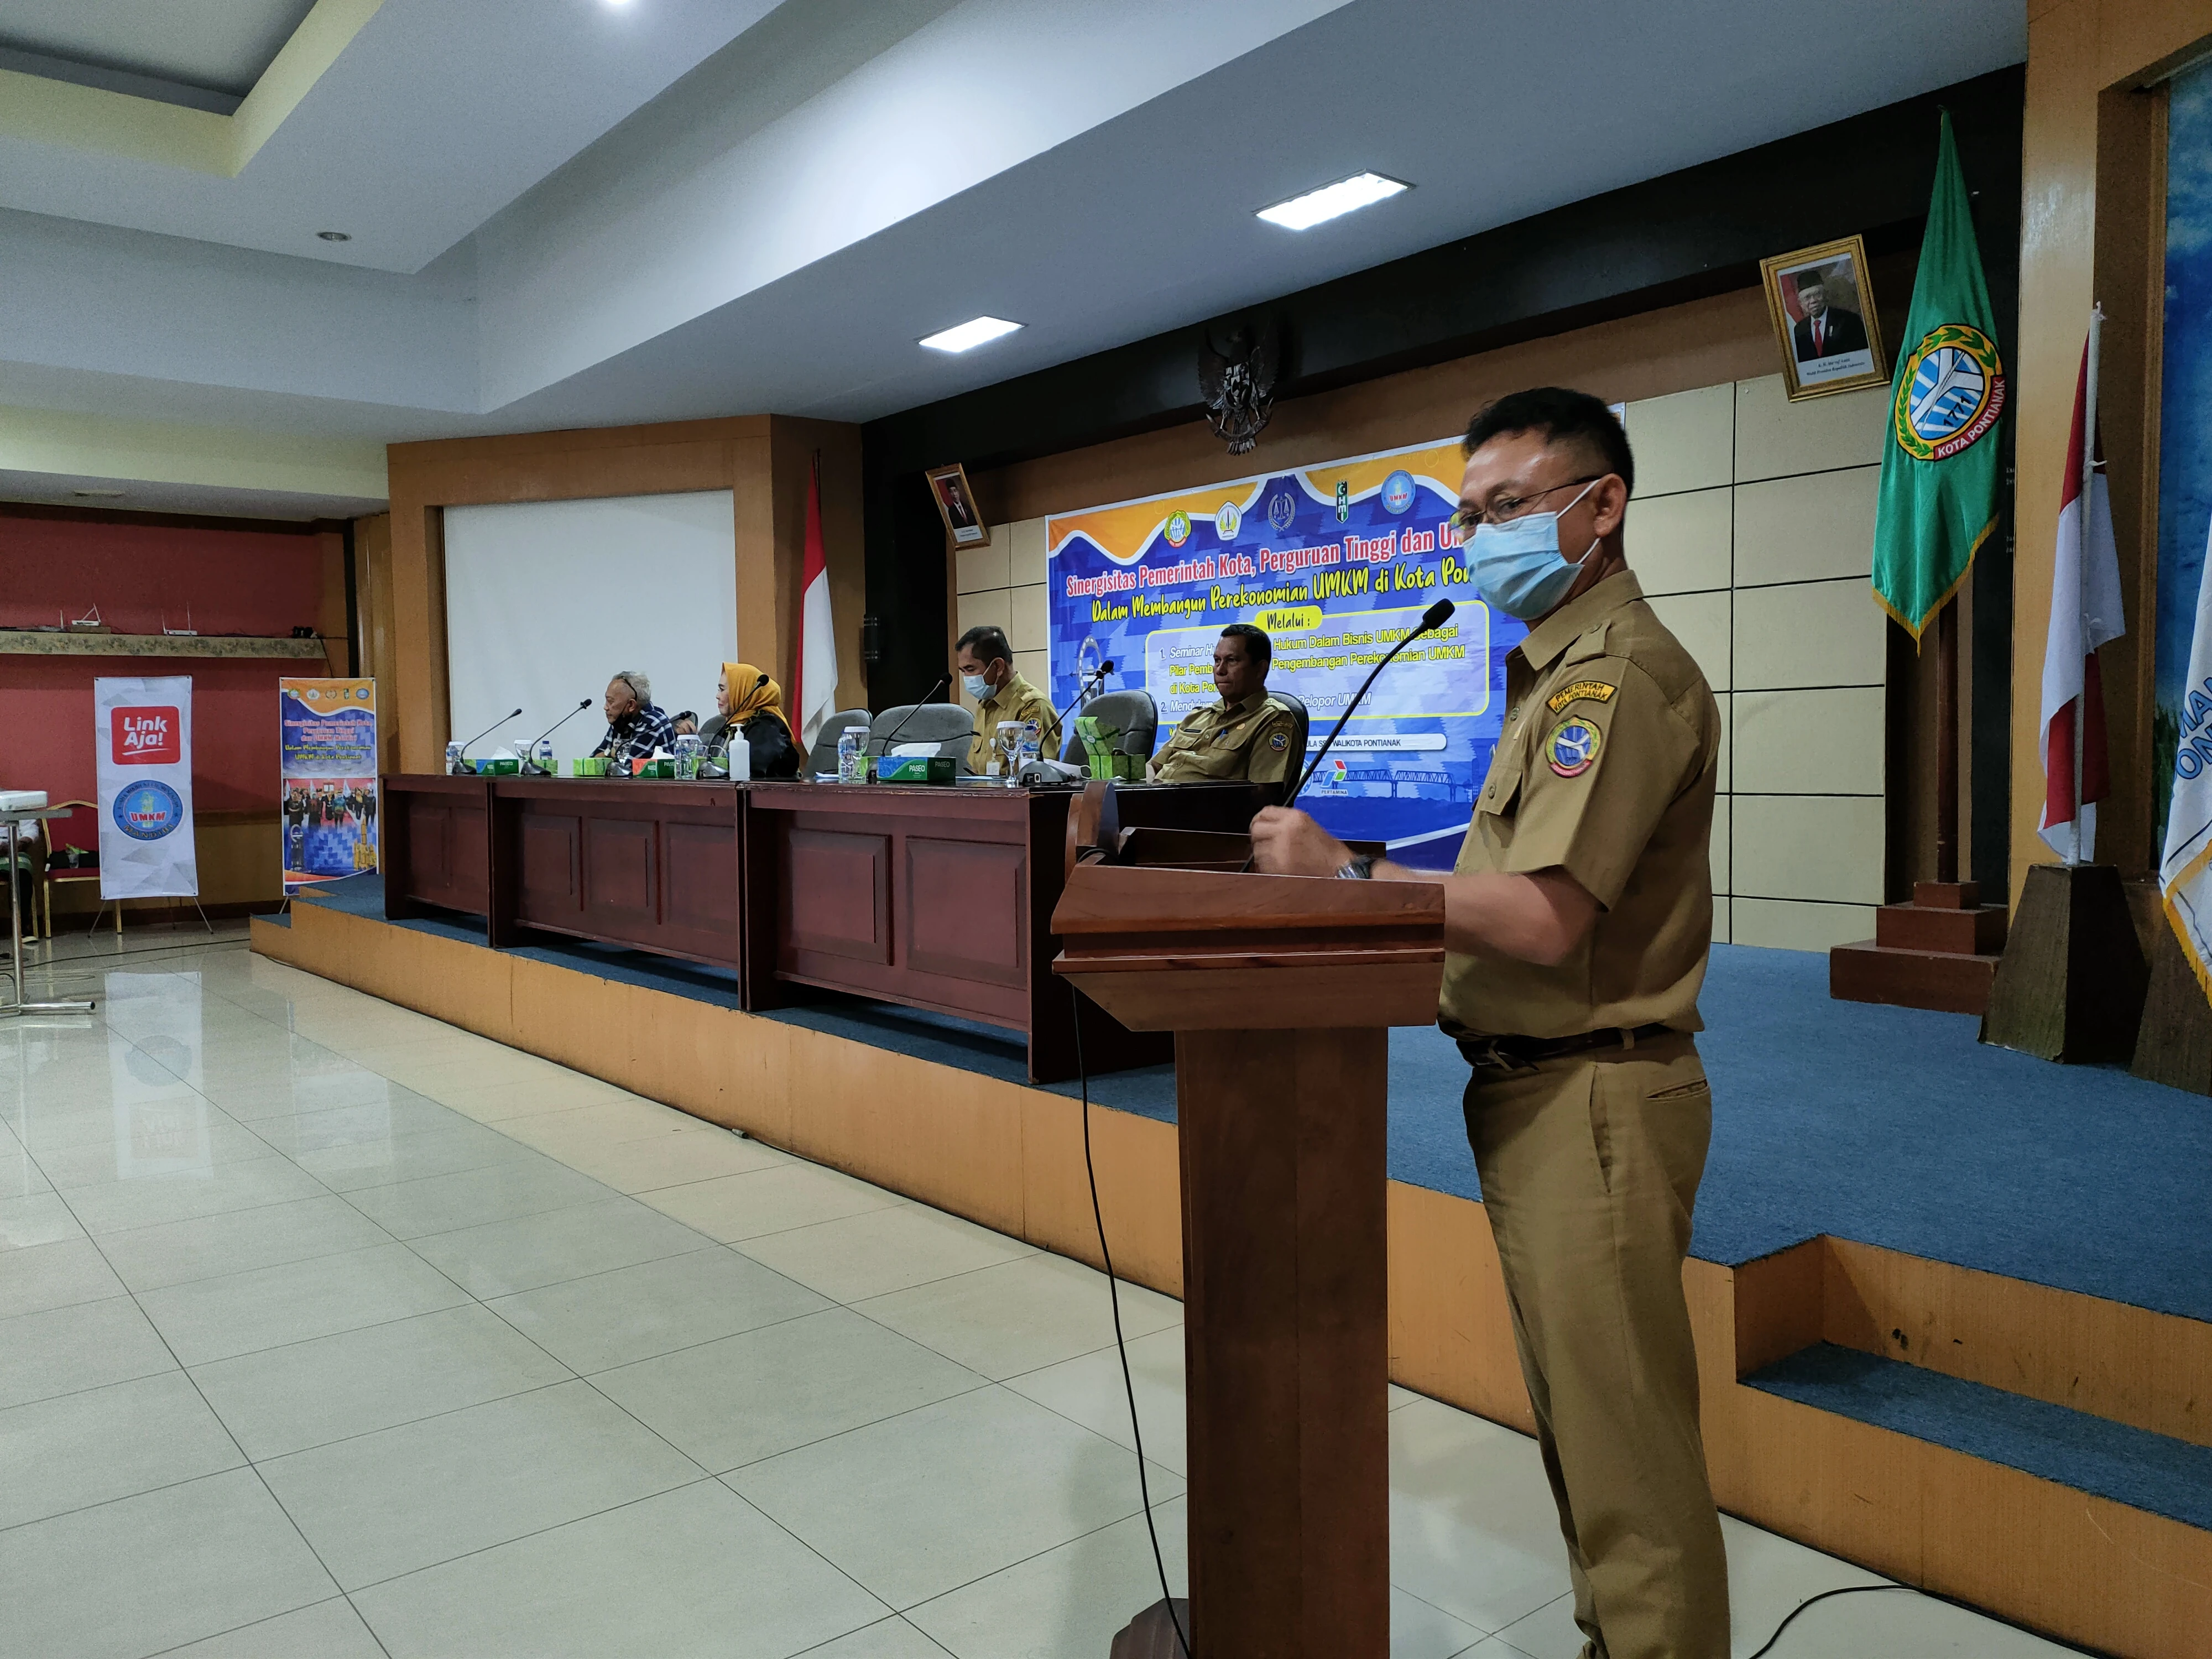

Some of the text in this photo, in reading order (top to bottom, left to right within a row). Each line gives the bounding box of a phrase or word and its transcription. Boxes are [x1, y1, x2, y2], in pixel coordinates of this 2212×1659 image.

[1937, 379, 2006, 458] KOTA PONTIANAK
[1943, 395, 1972, 427] 1771
[1389, 492, 1407, 502] UMKM
[1067, 570, 1136, 597] Sinergisitas
[1139, 556, 1215, 588] Pemerintah
[1219, 552, 1256, 578] Kota,
[1260, 544, 1340, 575] Perguruan
[1344, 530, 1396, 563] Tinggi
[1401, 527, 1434, 555] dan
[1092, 599, 1129, 623] Dalam
[1131, 593, 1207, 619] Membangun
[1210, 582, 1308, 609] Perekonomian
[1313, 567, 1369, 601] UMKM
[1375, 568, 1389, 593] di
[1395, 562, 1436, 591] Kota
[1267, 612, 1304, 630] Melalui
[1170, 646, 1203, 659] Seminar
[1273, 639, 1307, 651] Hukum
[1309, 635, 1340, 648] Dalam
[1342, 631, 1374, 645] Bisnis
[1375, 628, 1410, 643] UMKM
[1169, 665, 1187, 677] Pilar
[1271, 655, 1348, 673] Pengembangan
[1428, 645, 1465, 660] UMKM
[1170, 684, 1177, 695] di
[1179, 682, 1200, 694] Kota
[1555, 682, 1605, 702] PEMERINTAH
[1553, 690, 1608, 712] KOTA PONTIANAK
[123, 716, 168, 732] Link
[124, 731, 164, 750] Aja!
[130, 812, 165, 822] UMKM
[123, 823, 174, 838] MANDIRI
